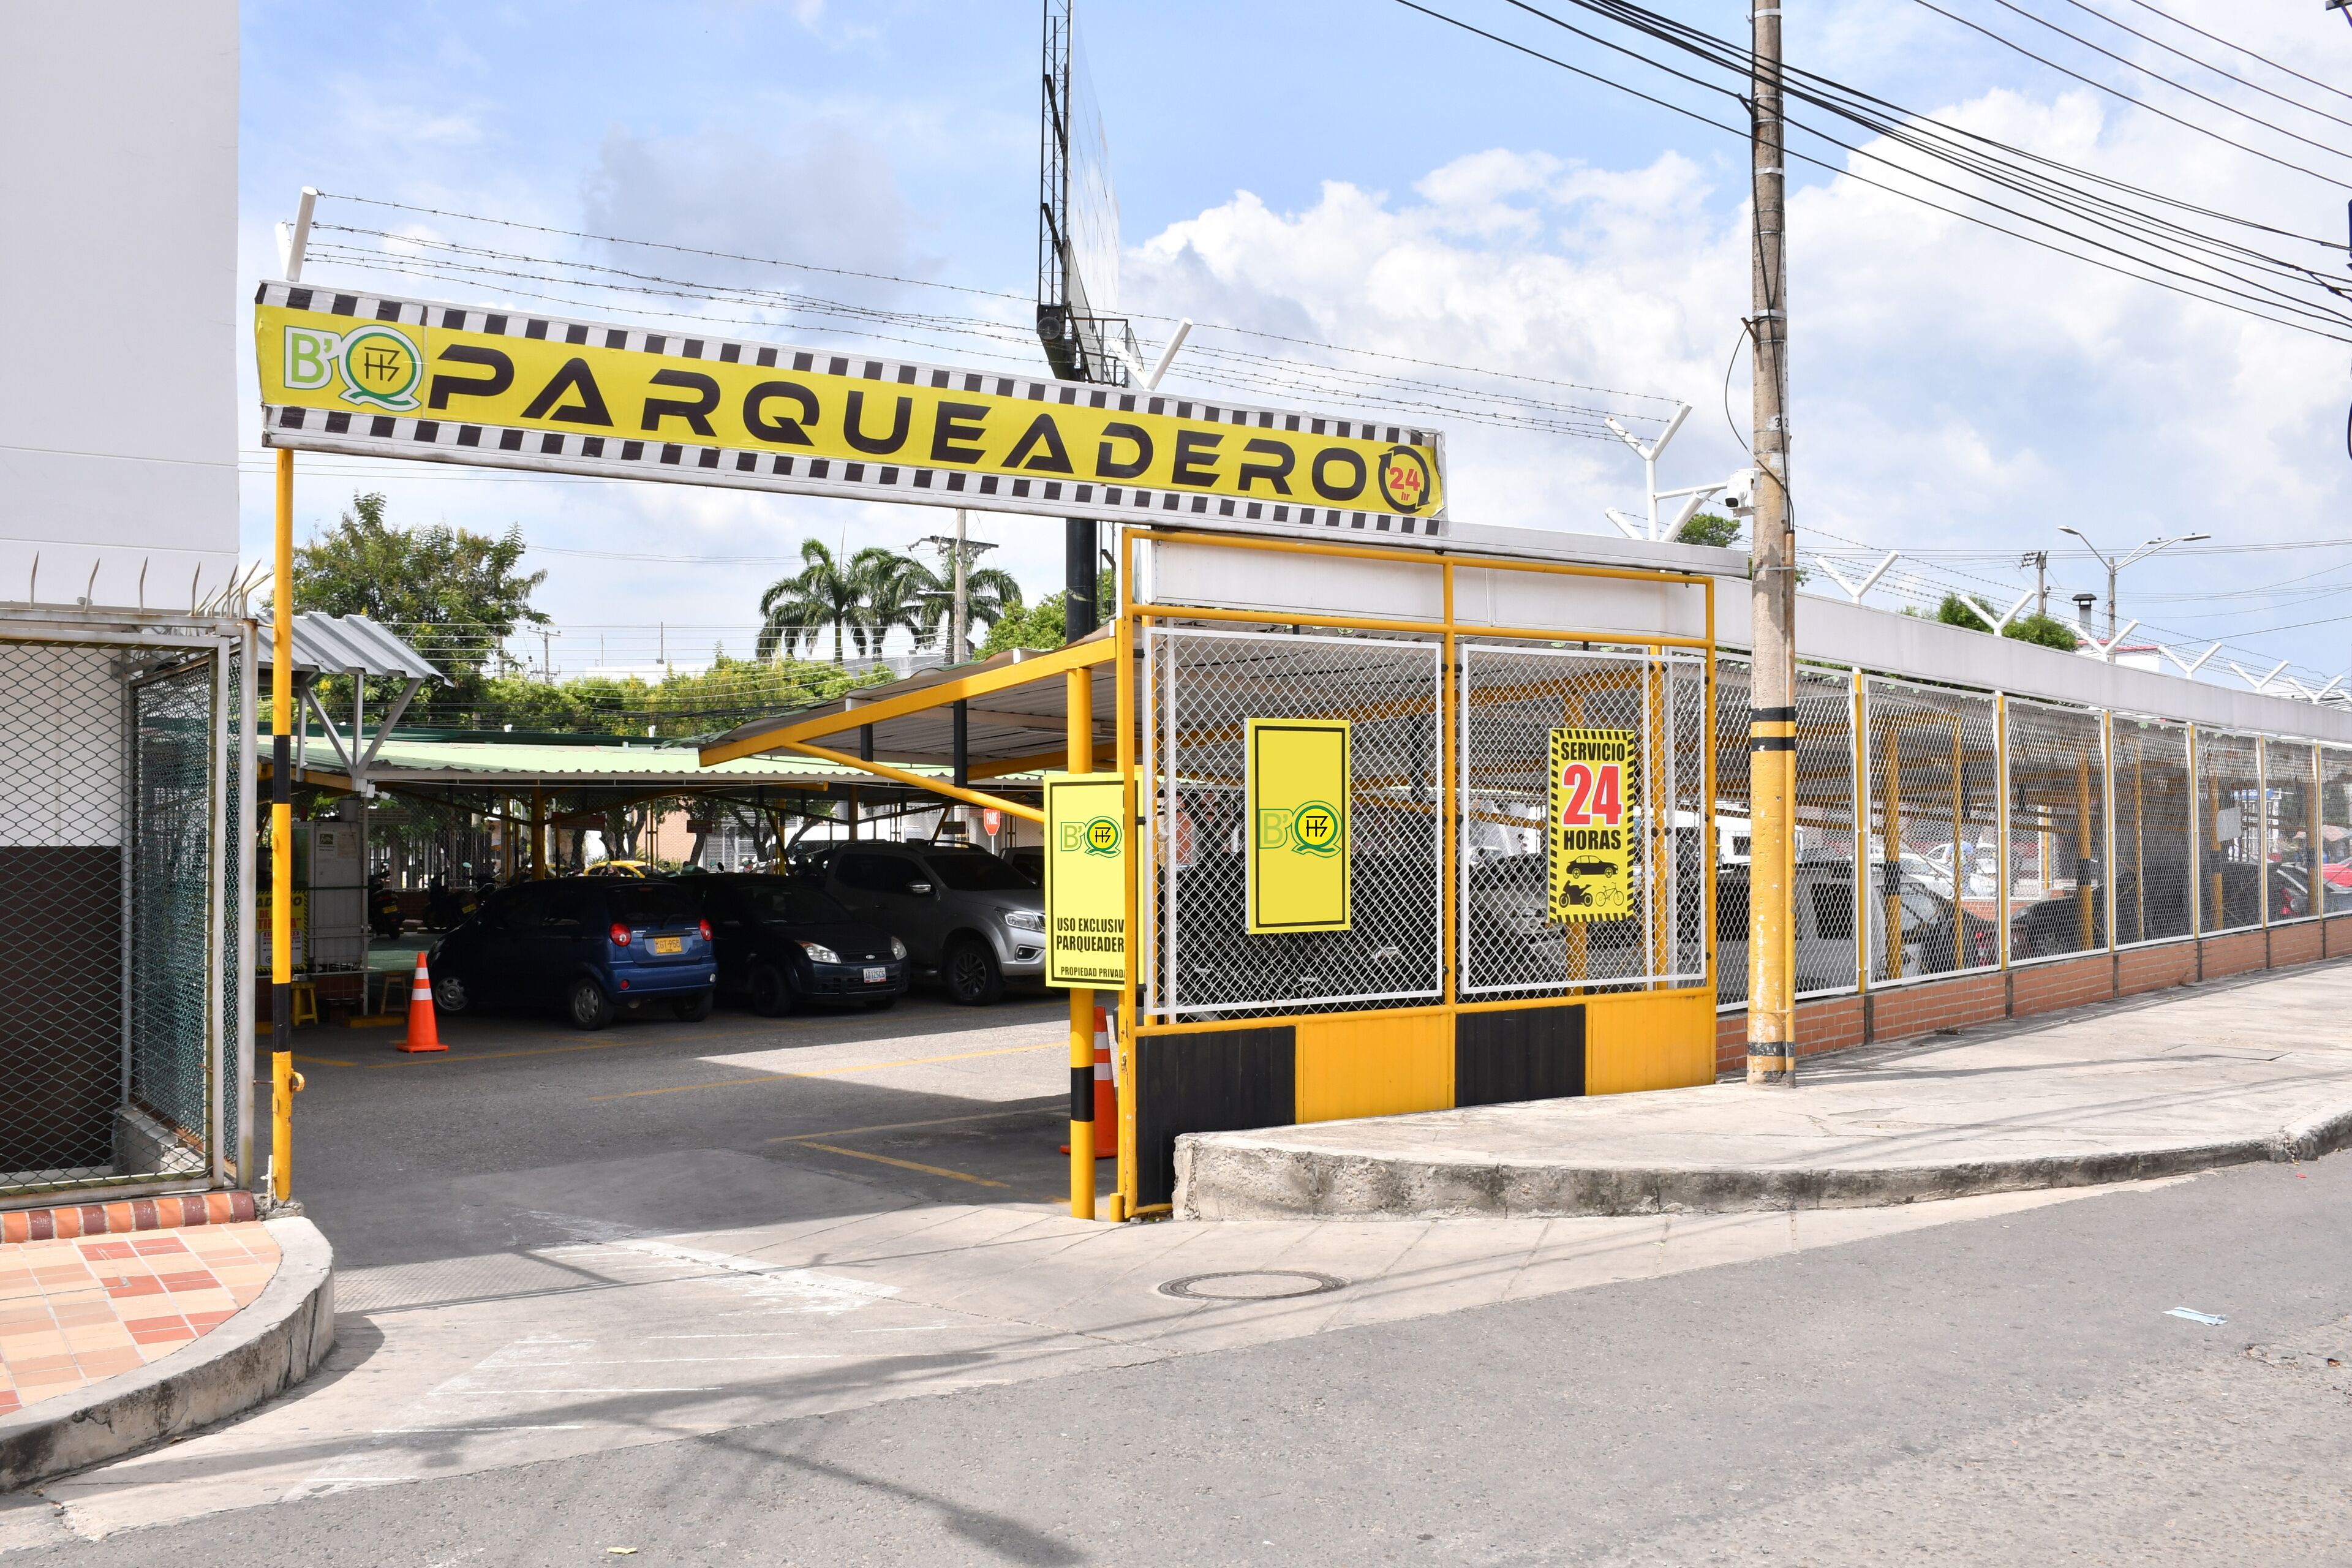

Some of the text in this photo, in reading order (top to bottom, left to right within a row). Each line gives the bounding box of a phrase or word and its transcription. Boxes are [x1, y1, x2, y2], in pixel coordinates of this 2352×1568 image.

[428, 344, 1366, 502] PARQUEADERO
[1389, 467, 1420, 491] 24
[1401, 492, 1410, 501] hr
[1561, 742, 1625, 761] SERVICIO
[1563, 763, 1622, 825] 24
[986, 812, 998, 824] PARE
[1564, 830, 1621, 850] HORAS
[1057, 918, 1125, 933] USO EXCLUSIV
[1057, 935, 1125, 952] PARQUEADER
[1061, 967, 1097, 977] PROPIEDAD
